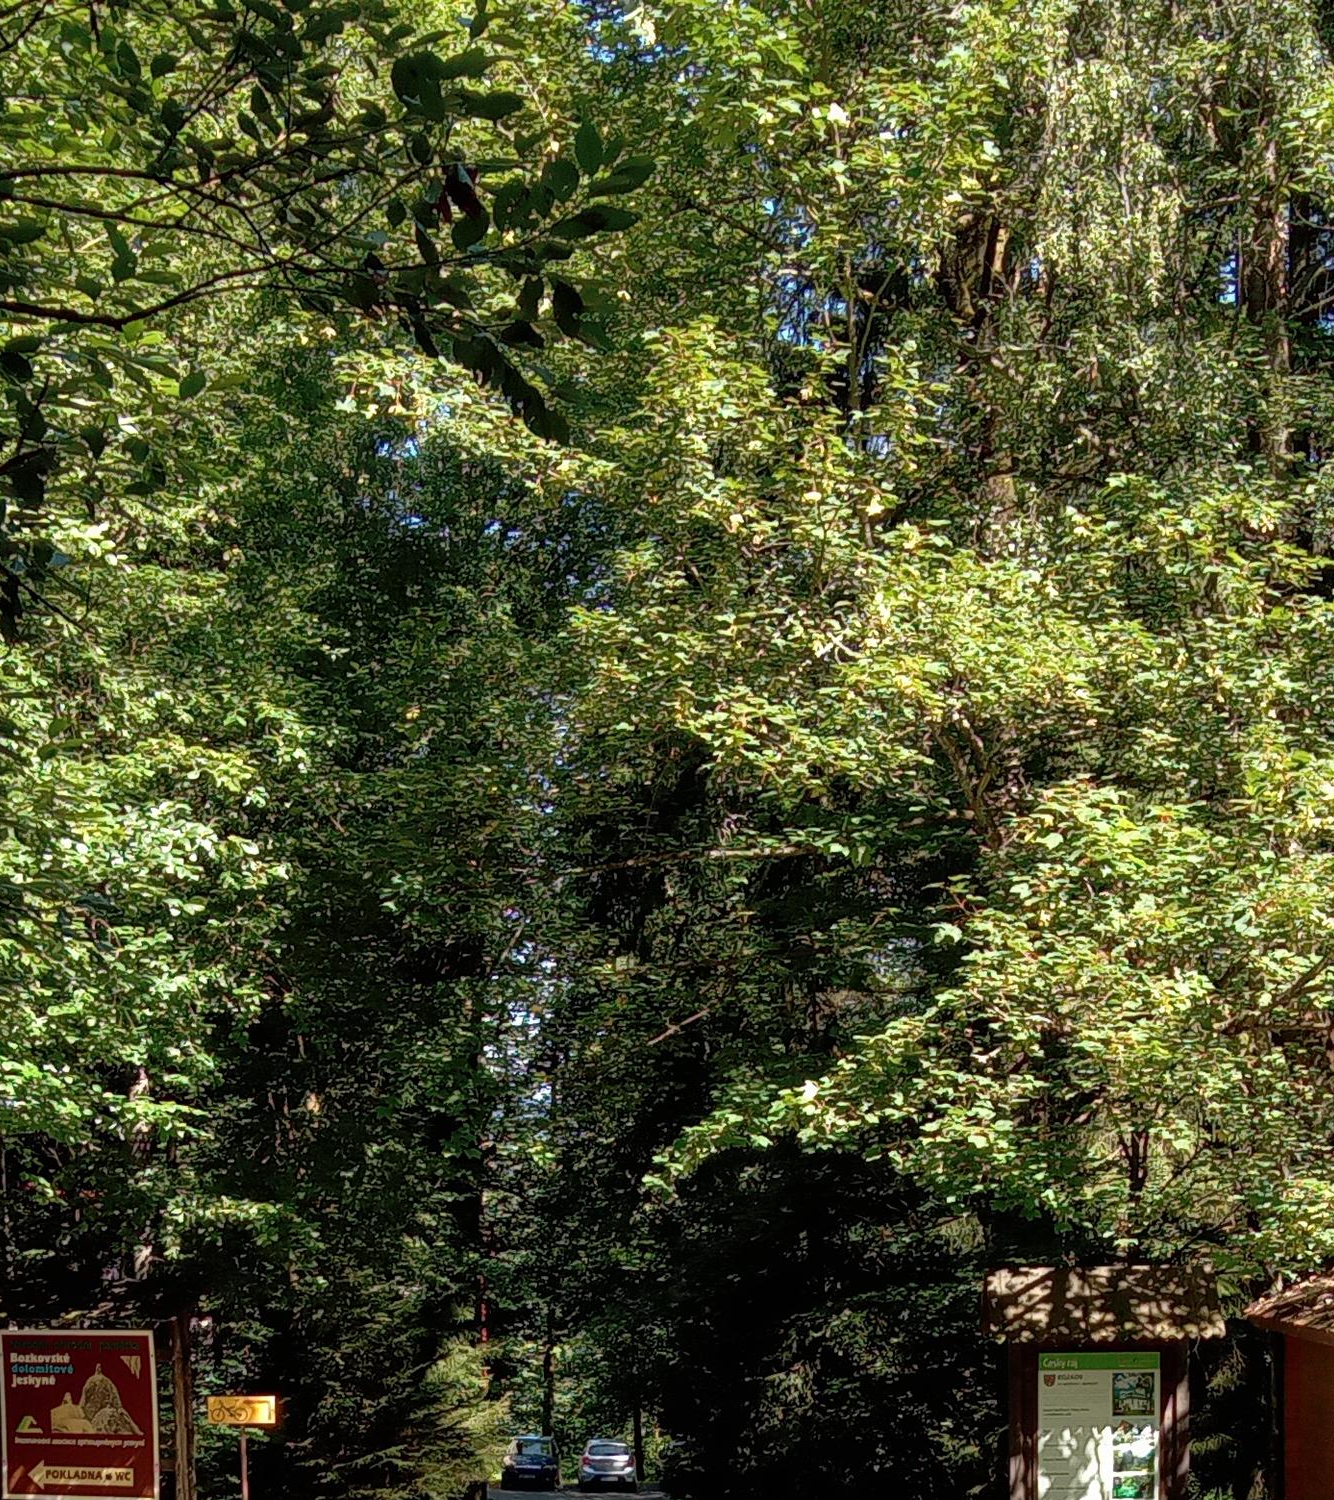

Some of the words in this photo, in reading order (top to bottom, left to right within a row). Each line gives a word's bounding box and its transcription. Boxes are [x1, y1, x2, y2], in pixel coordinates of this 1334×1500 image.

[10, 1353, 70, 1363] Bozkovské
[11, 1364, 74, 1374] dolomitové
[45, 1469, 102, 1480] POKLADNA
[114, 1471, 131, 1481] WC
